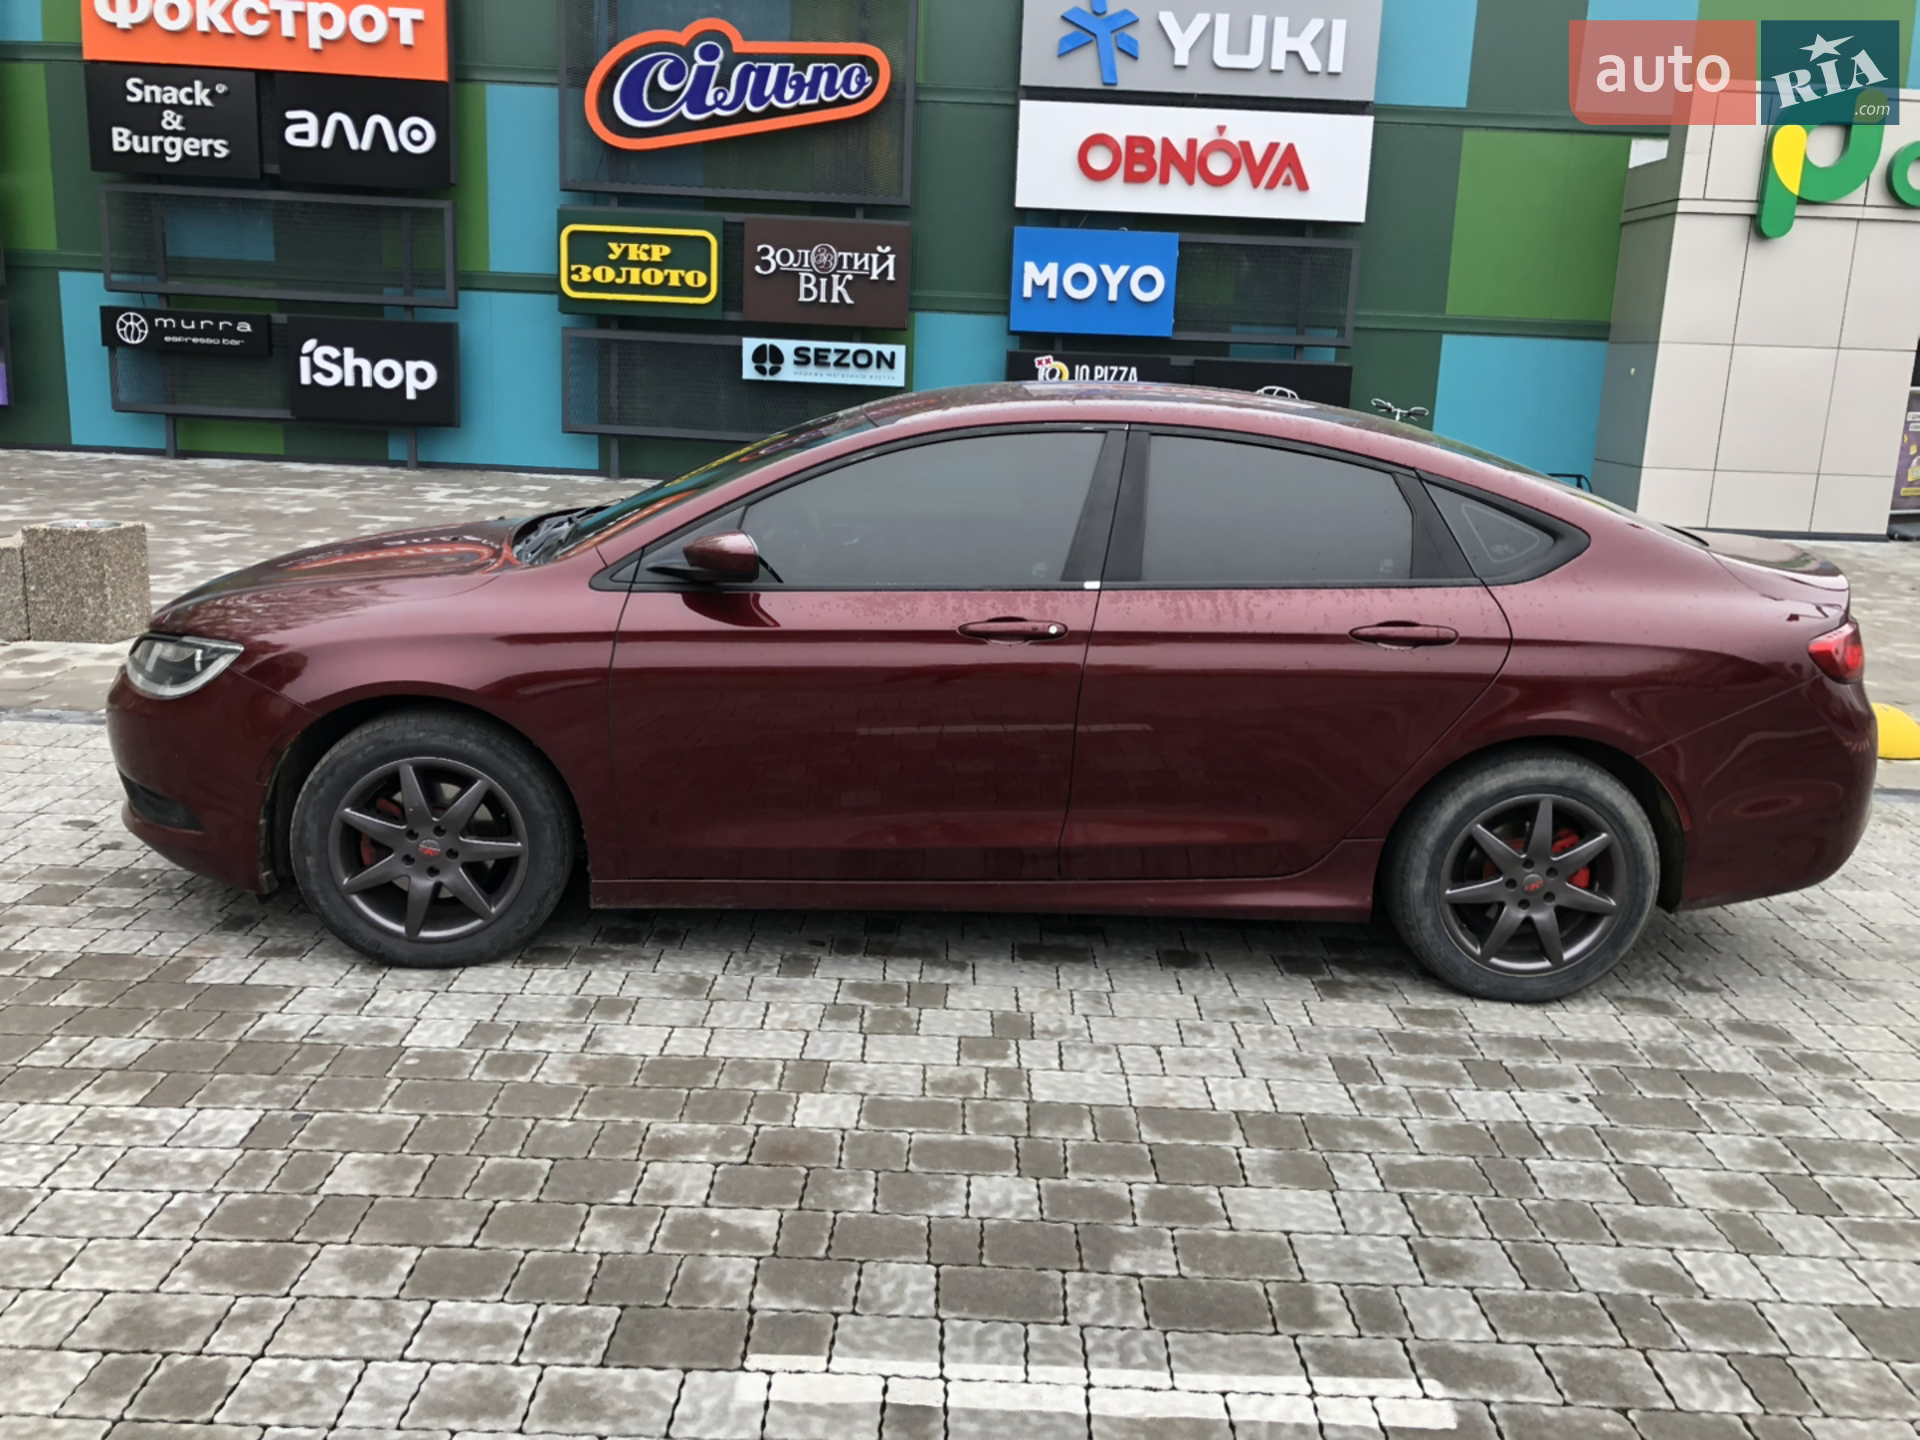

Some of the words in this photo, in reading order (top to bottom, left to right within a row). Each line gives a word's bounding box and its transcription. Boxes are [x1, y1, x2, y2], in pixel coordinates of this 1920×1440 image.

[1158, 10, 1348, 75] YUKI
[125, 77, 213, 108] Snack
[613, 40, 872, 128] Сільпо
[161, 110, 185, 131] &
[111, 126, 231, 162] Burgers
[607, 241, 672, 263] УКР
[570, 265, 708, 289] ЗОЛОТО
[1022, 260, 1165, 303] MOYO
[154, 317, 253, 333] murra
[221, 338, 245, 346] bar
[299, 338, 438, 400] iShop
[793, 346, 896, 370] SEZON
[1094, 365, 1138, 382] PIZZA
